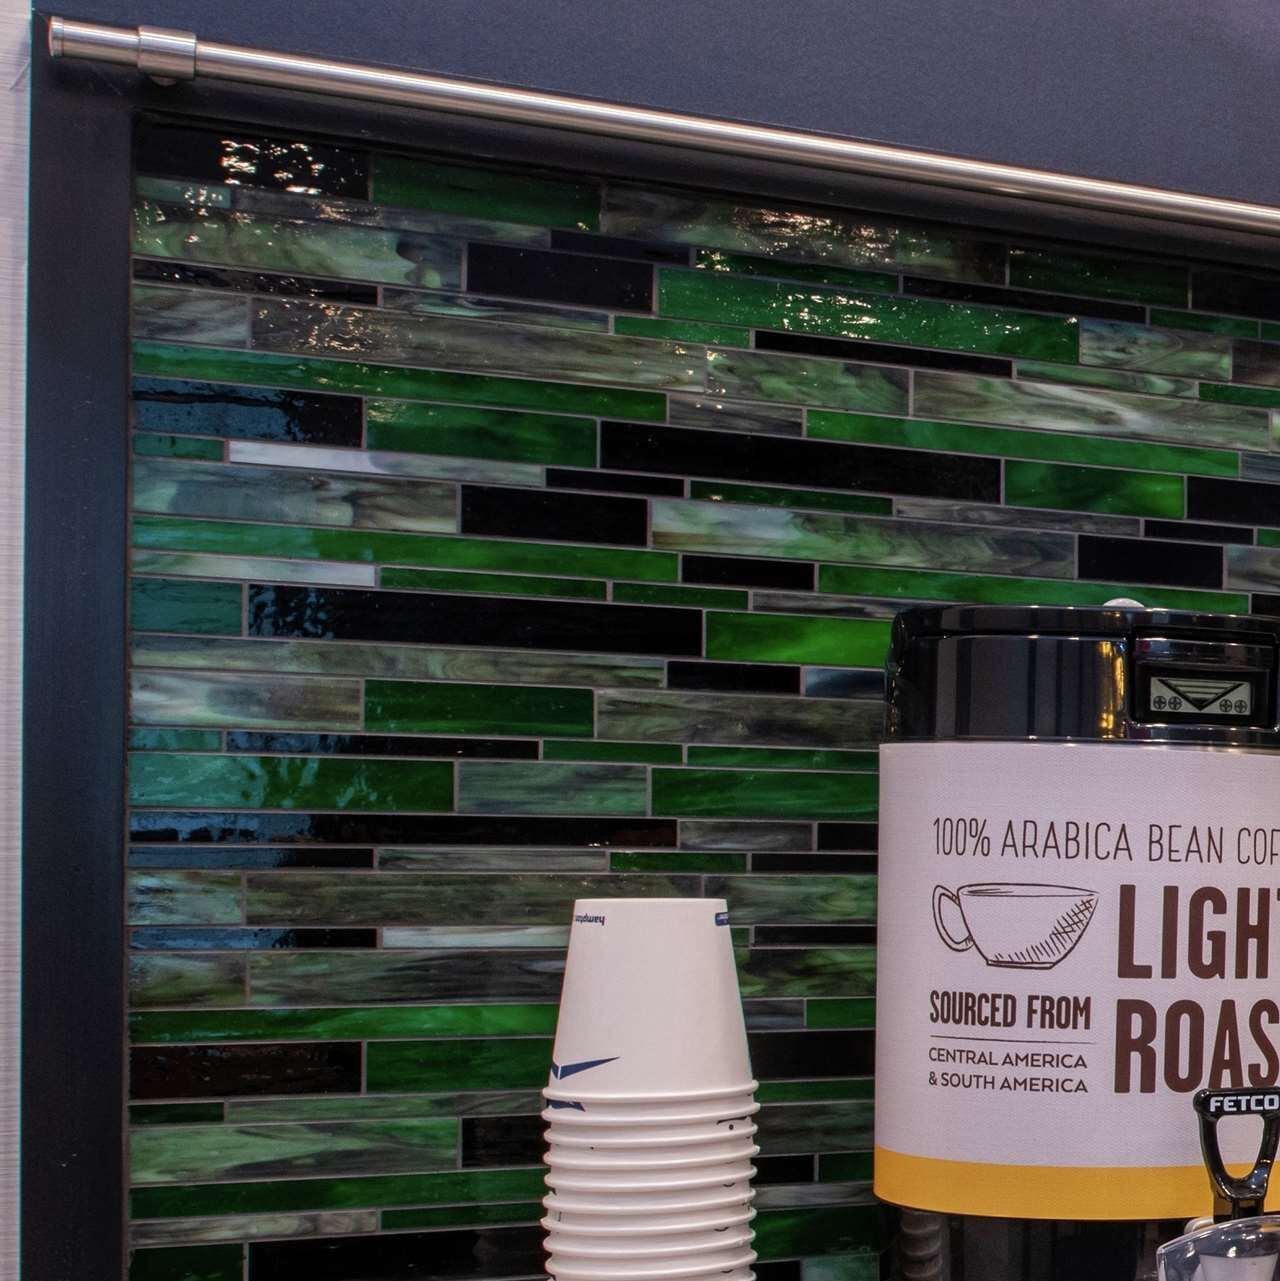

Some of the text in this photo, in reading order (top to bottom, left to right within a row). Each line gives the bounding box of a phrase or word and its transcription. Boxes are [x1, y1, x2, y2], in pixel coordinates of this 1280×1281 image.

[932, 817, 990, 858] 100%
[1001, 817, 1132, 862] ARABICA
[1148, 824, 1224, 865] BEAN
[929, 989, 1092, 1031] SOURCED FROM
[928, 1046, 1088, 1070] CENTRAL AMERICA
[928, 1071, 1089, 1094] & SOUTH AMERICA
[1209, 1094, 1280, 1112] FETCO
